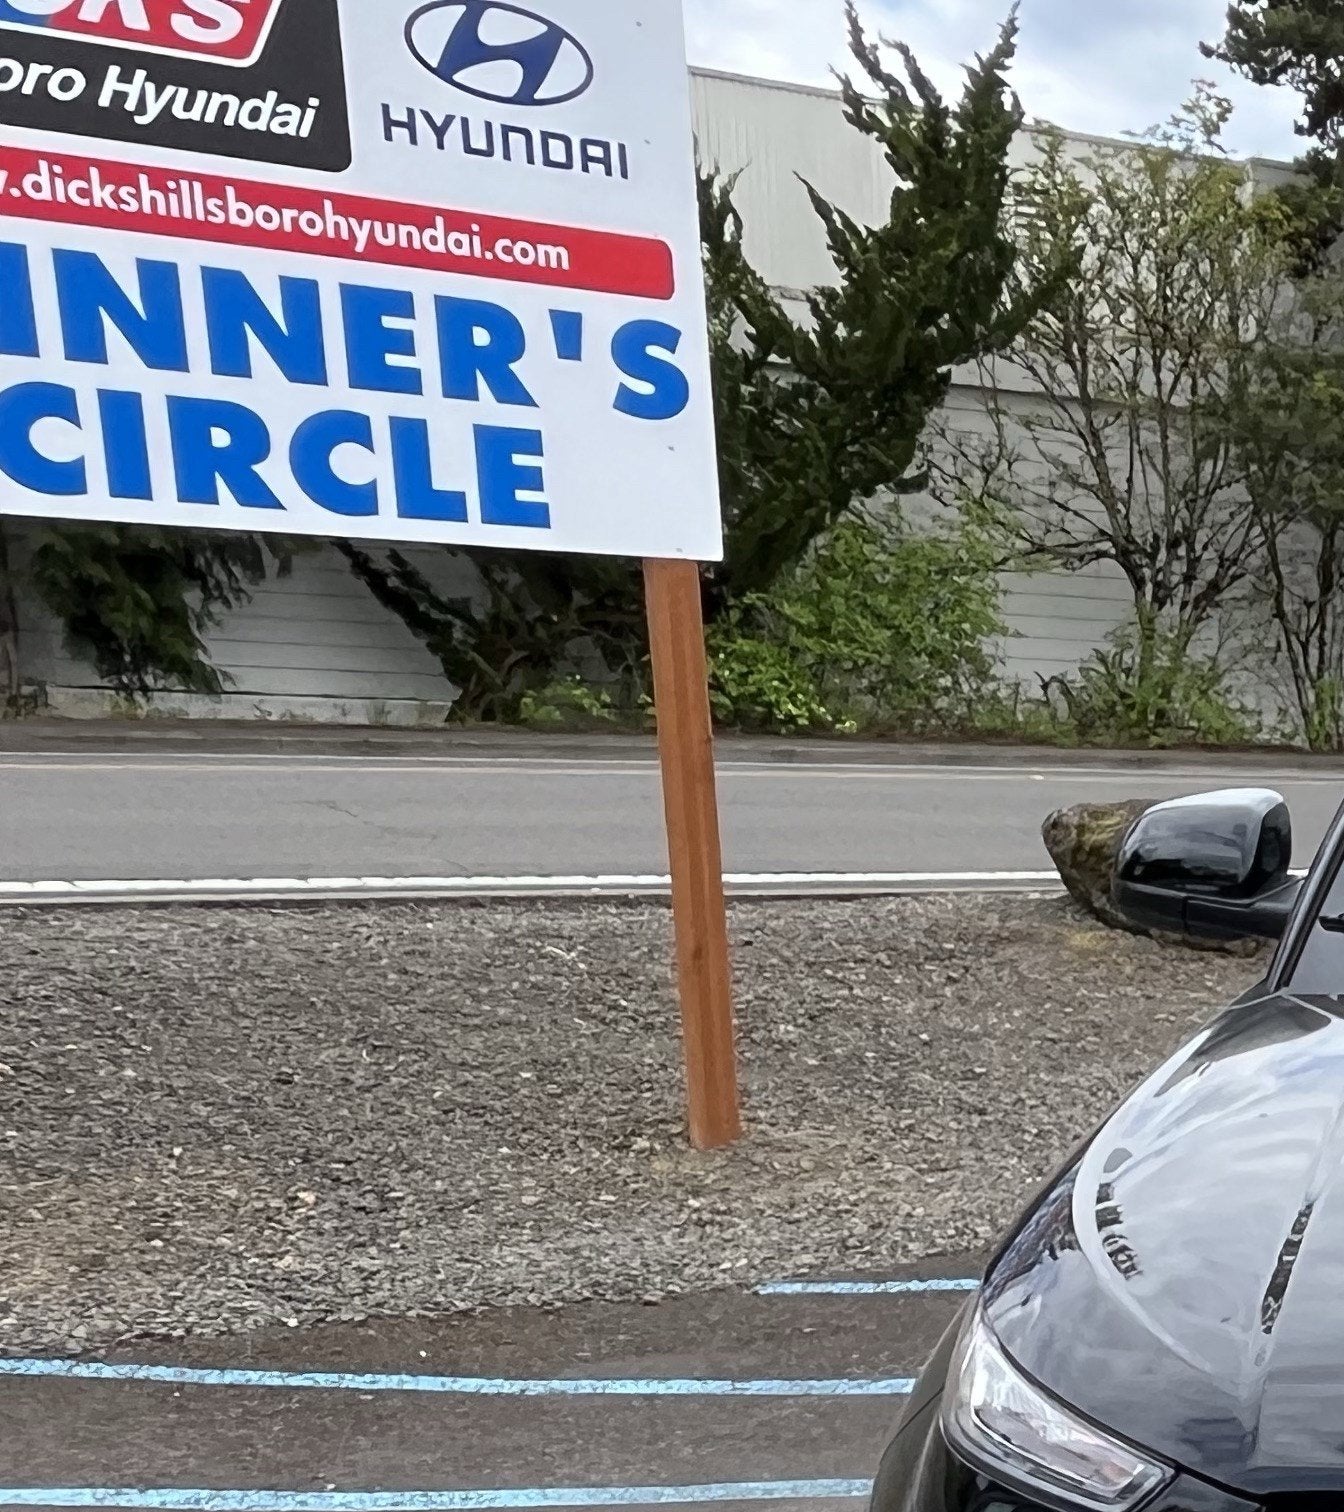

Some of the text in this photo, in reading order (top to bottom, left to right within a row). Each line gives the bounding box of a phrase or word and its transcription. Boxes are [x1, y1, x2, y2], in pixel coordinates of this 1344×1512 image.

[98, 65, 320, 138] Hyundai
[381, 103, 629, 180] HYUNDAI
[0, 381, 551, 529] CIRCLE
